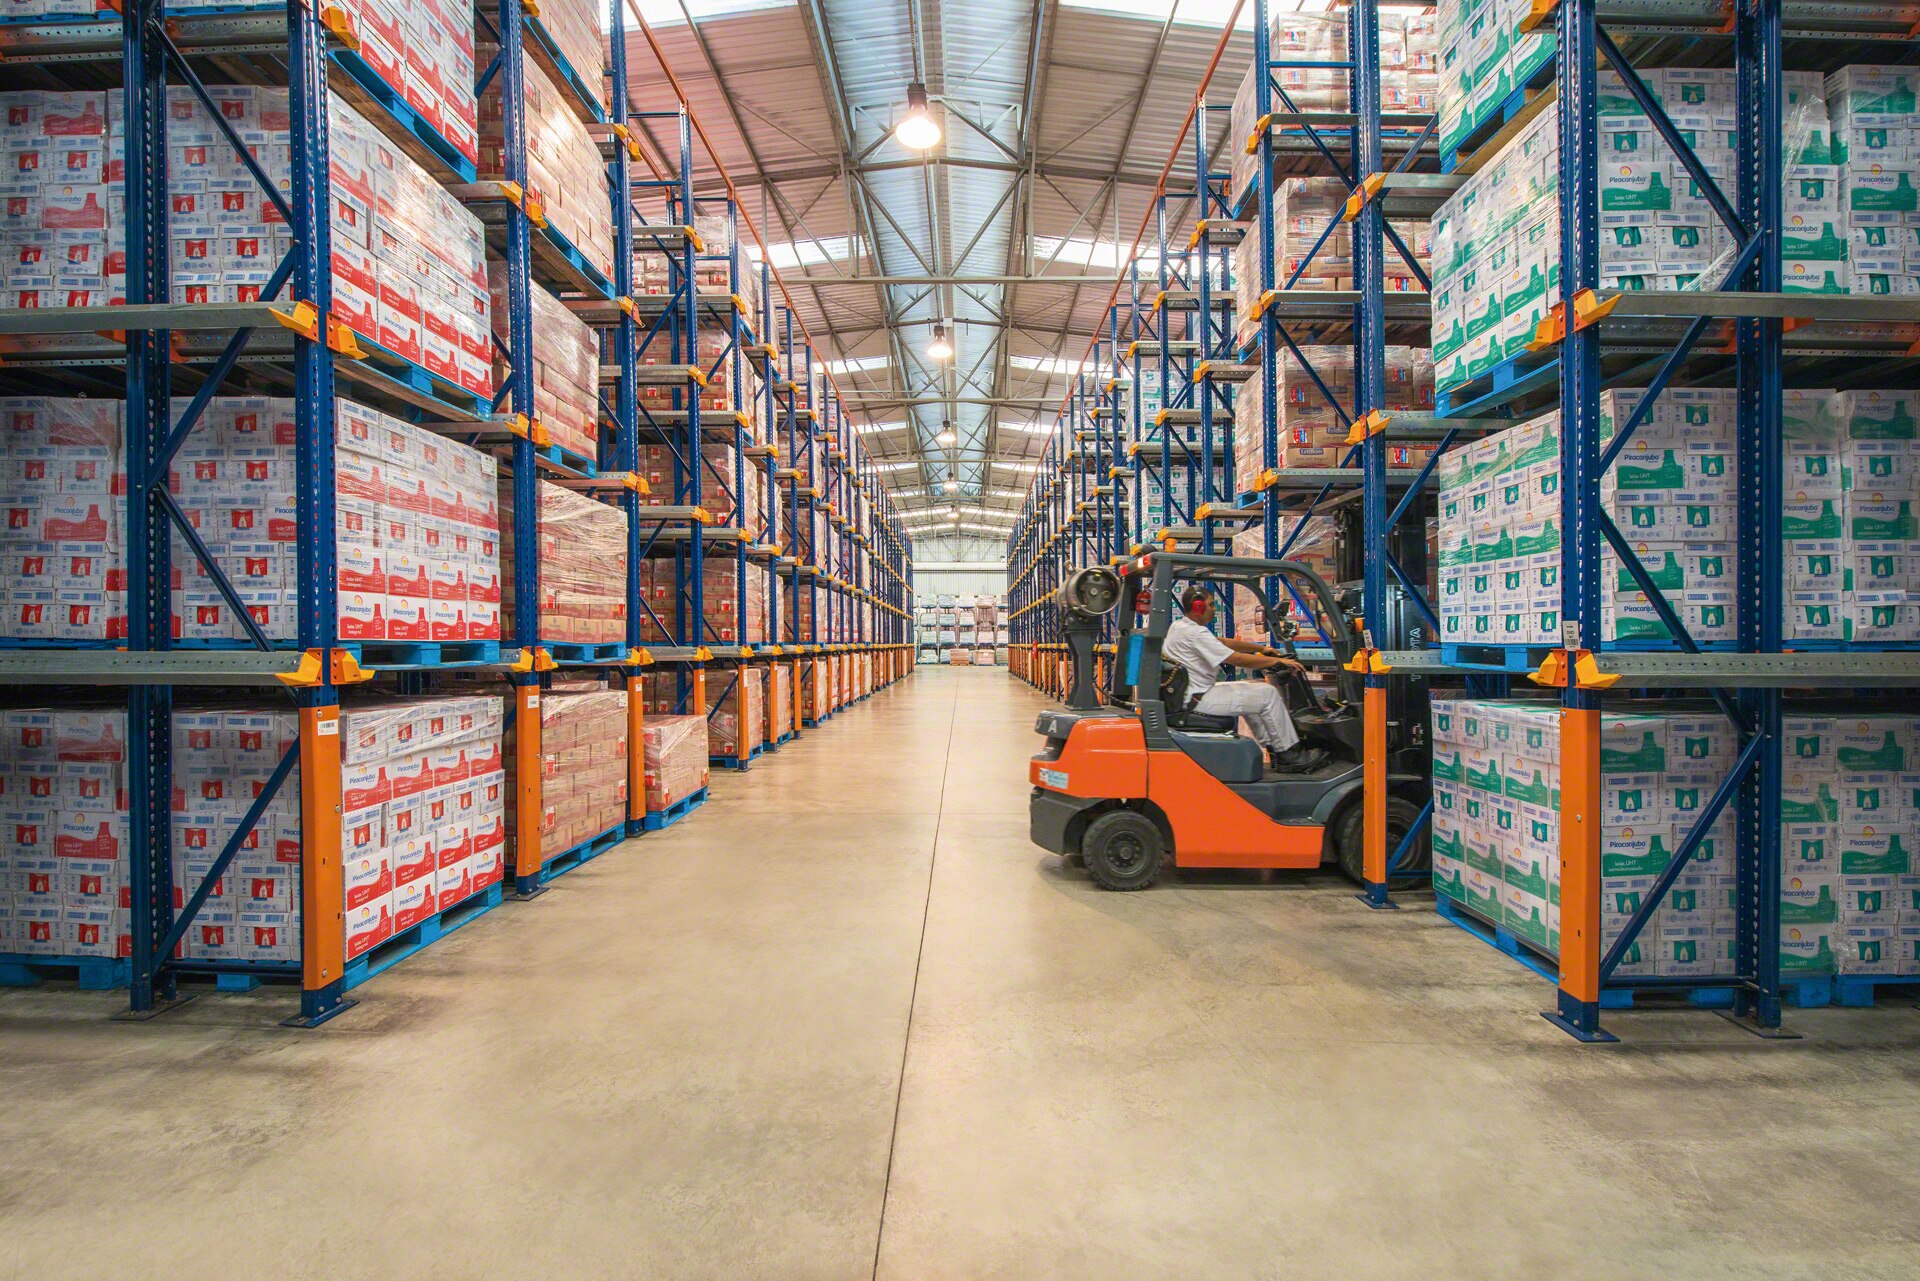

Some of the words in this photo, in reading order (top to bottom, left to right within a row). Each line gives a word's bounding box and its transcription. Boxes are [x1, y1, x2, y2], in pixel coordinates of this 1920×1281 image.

[1624, 454, 1659, 462] Piracanjuba
[1784, 505, 1818, 513] Piracanjuba
[64, 824, 95, 833] Piracanjuba
